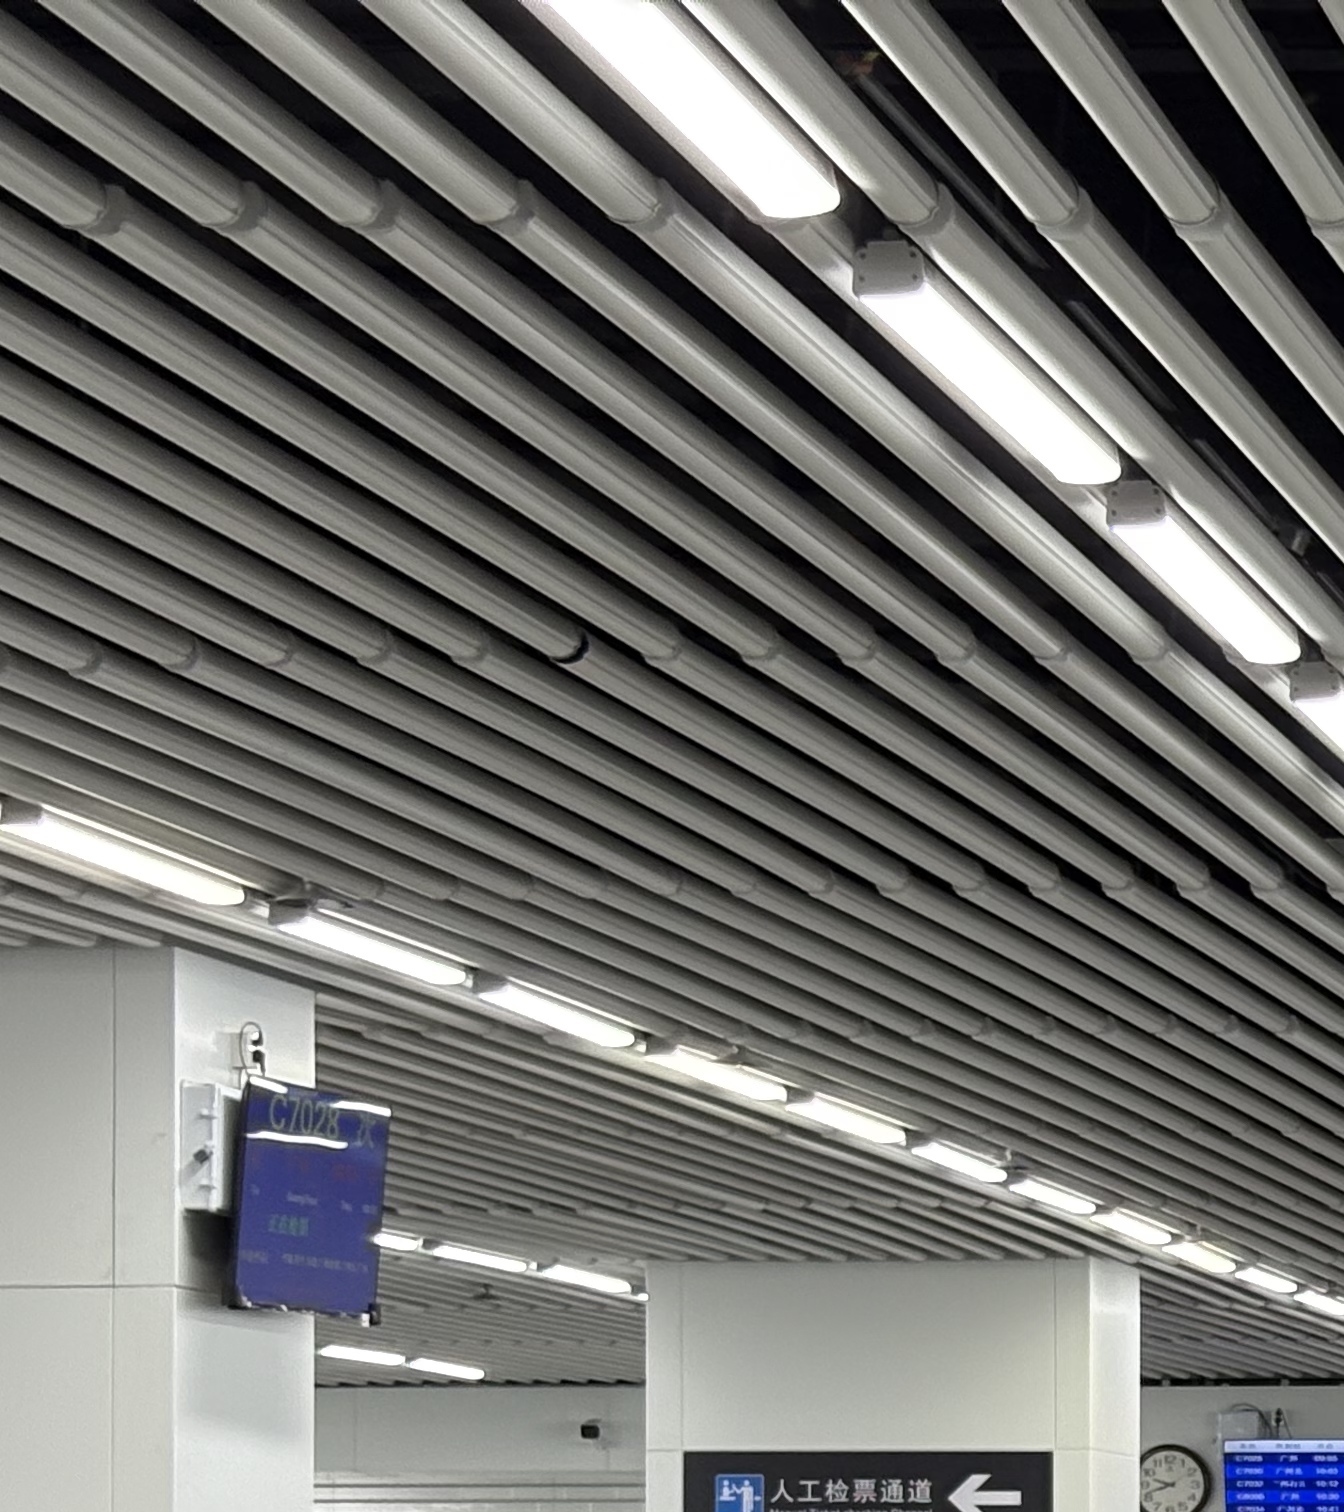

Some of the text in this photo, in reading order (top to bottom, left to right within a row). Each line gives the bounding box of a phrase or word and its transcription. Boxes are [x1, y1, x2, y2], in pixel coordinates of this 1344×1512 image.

[269, 1093, 339, 1138] C7028
[770, 1478, 933, 1504] 人工检票通道
